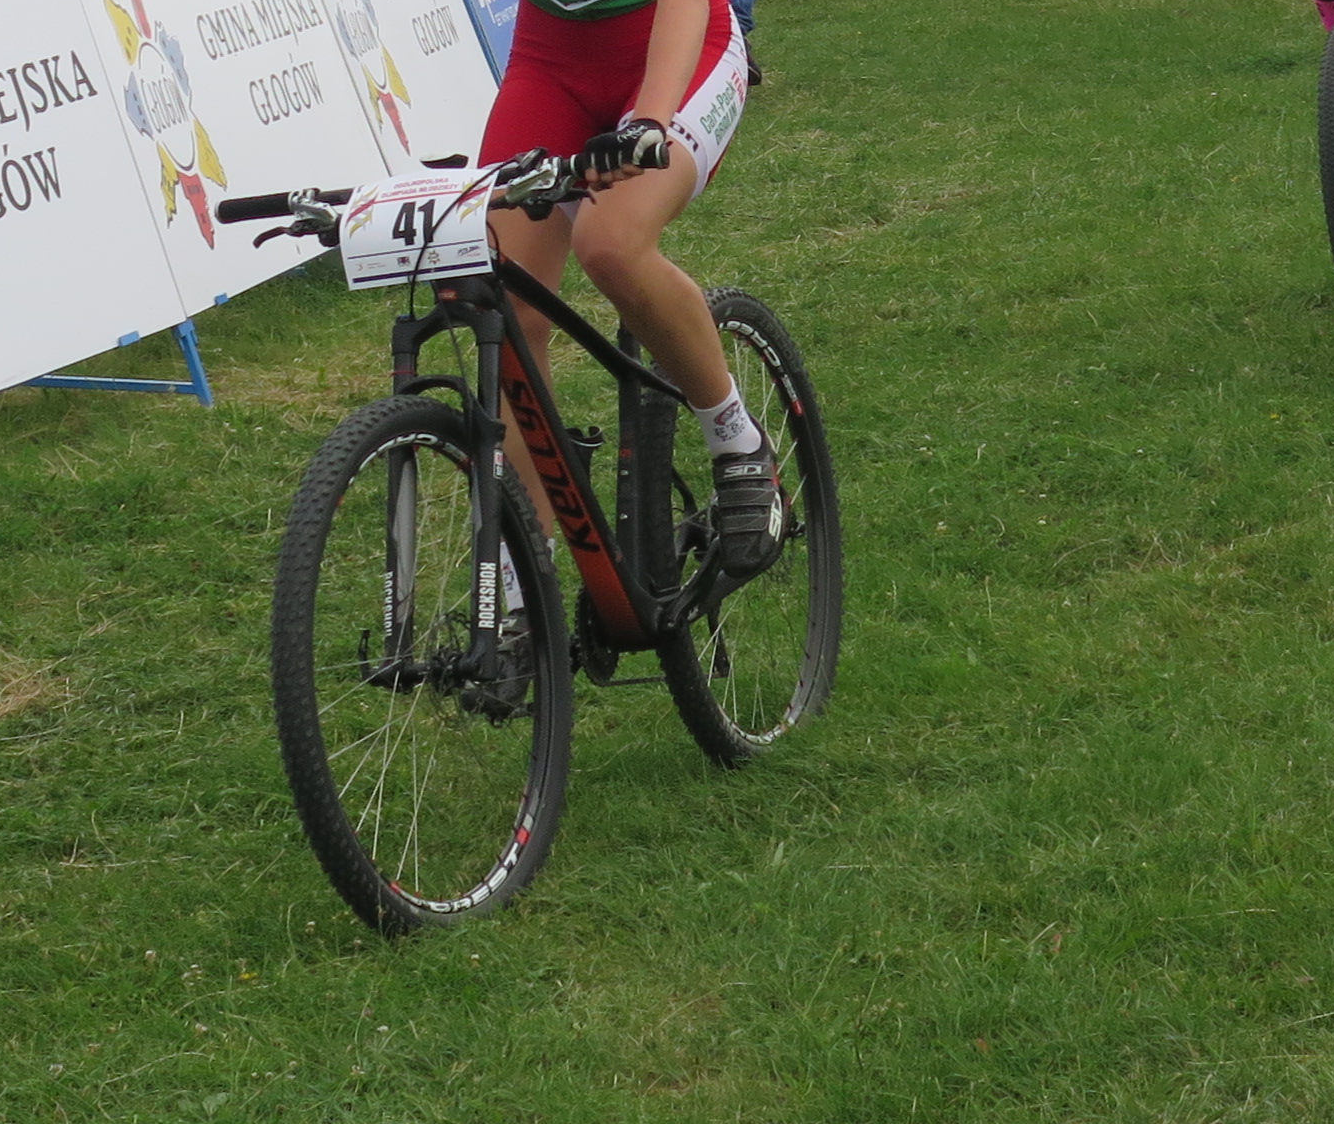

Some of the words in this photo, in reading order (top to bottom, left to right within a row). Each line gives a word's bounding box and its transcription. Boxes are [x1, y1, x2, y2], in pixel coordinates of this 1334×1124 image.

[196, 2, 262, 61] GMINA
[249, 52, 325, 126] GŁOGÓW
[392, 198, 436, 246] 41
[478, 561, 497, 629] ROCKSHOX
